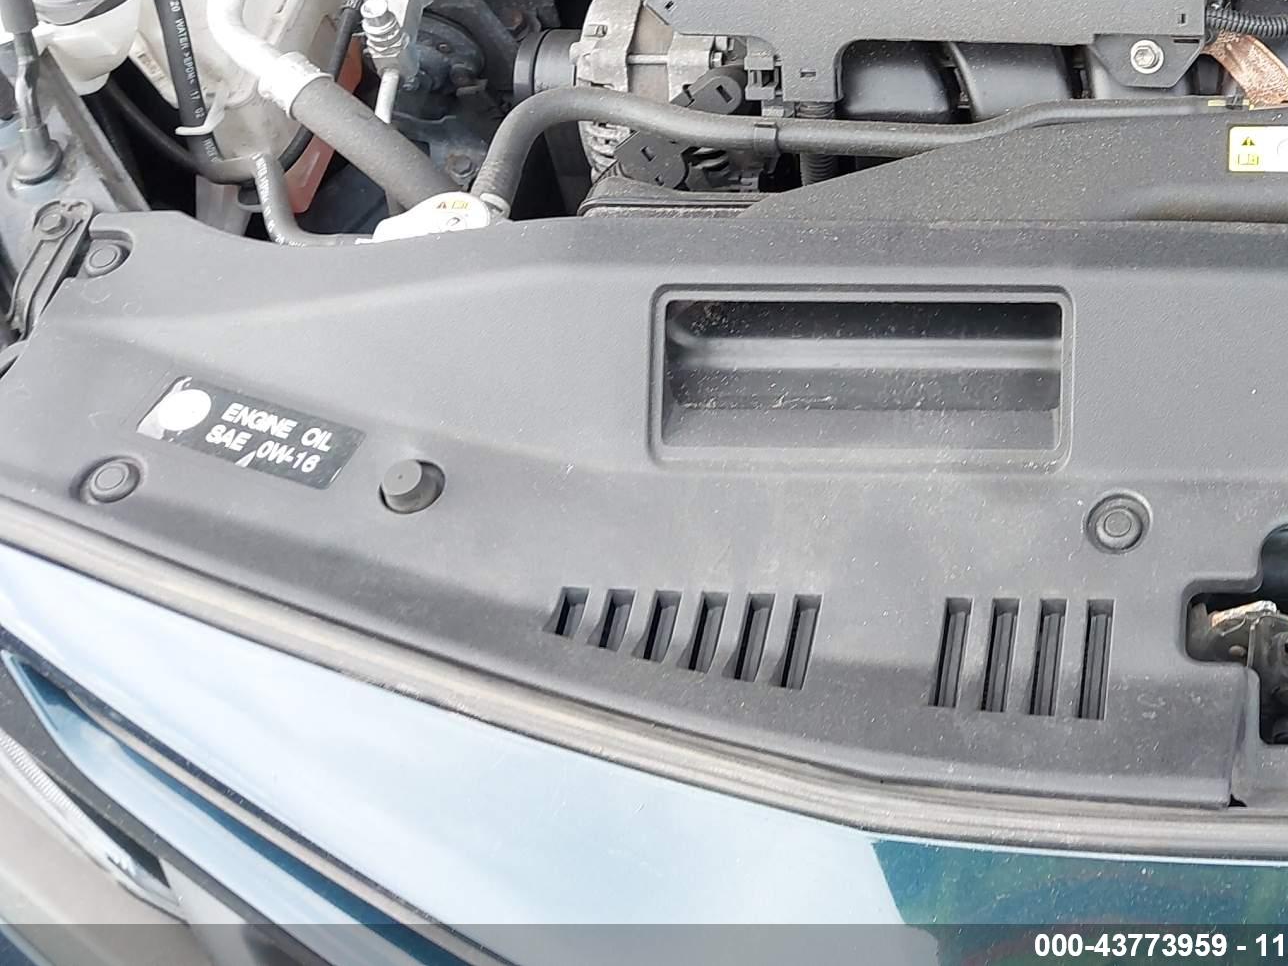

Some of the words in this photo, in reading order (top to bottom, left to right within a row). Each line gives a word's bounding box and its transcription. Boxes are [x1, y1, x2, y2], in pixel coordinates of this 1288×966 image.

[175, 18, 190, 50] WATER
[204, 424, 254, 452] SAE
[255, 440, 321, 473] 0W-16
[220, 402, 299, 440] ENGINE
[300, 427, 334, 452] OIL
